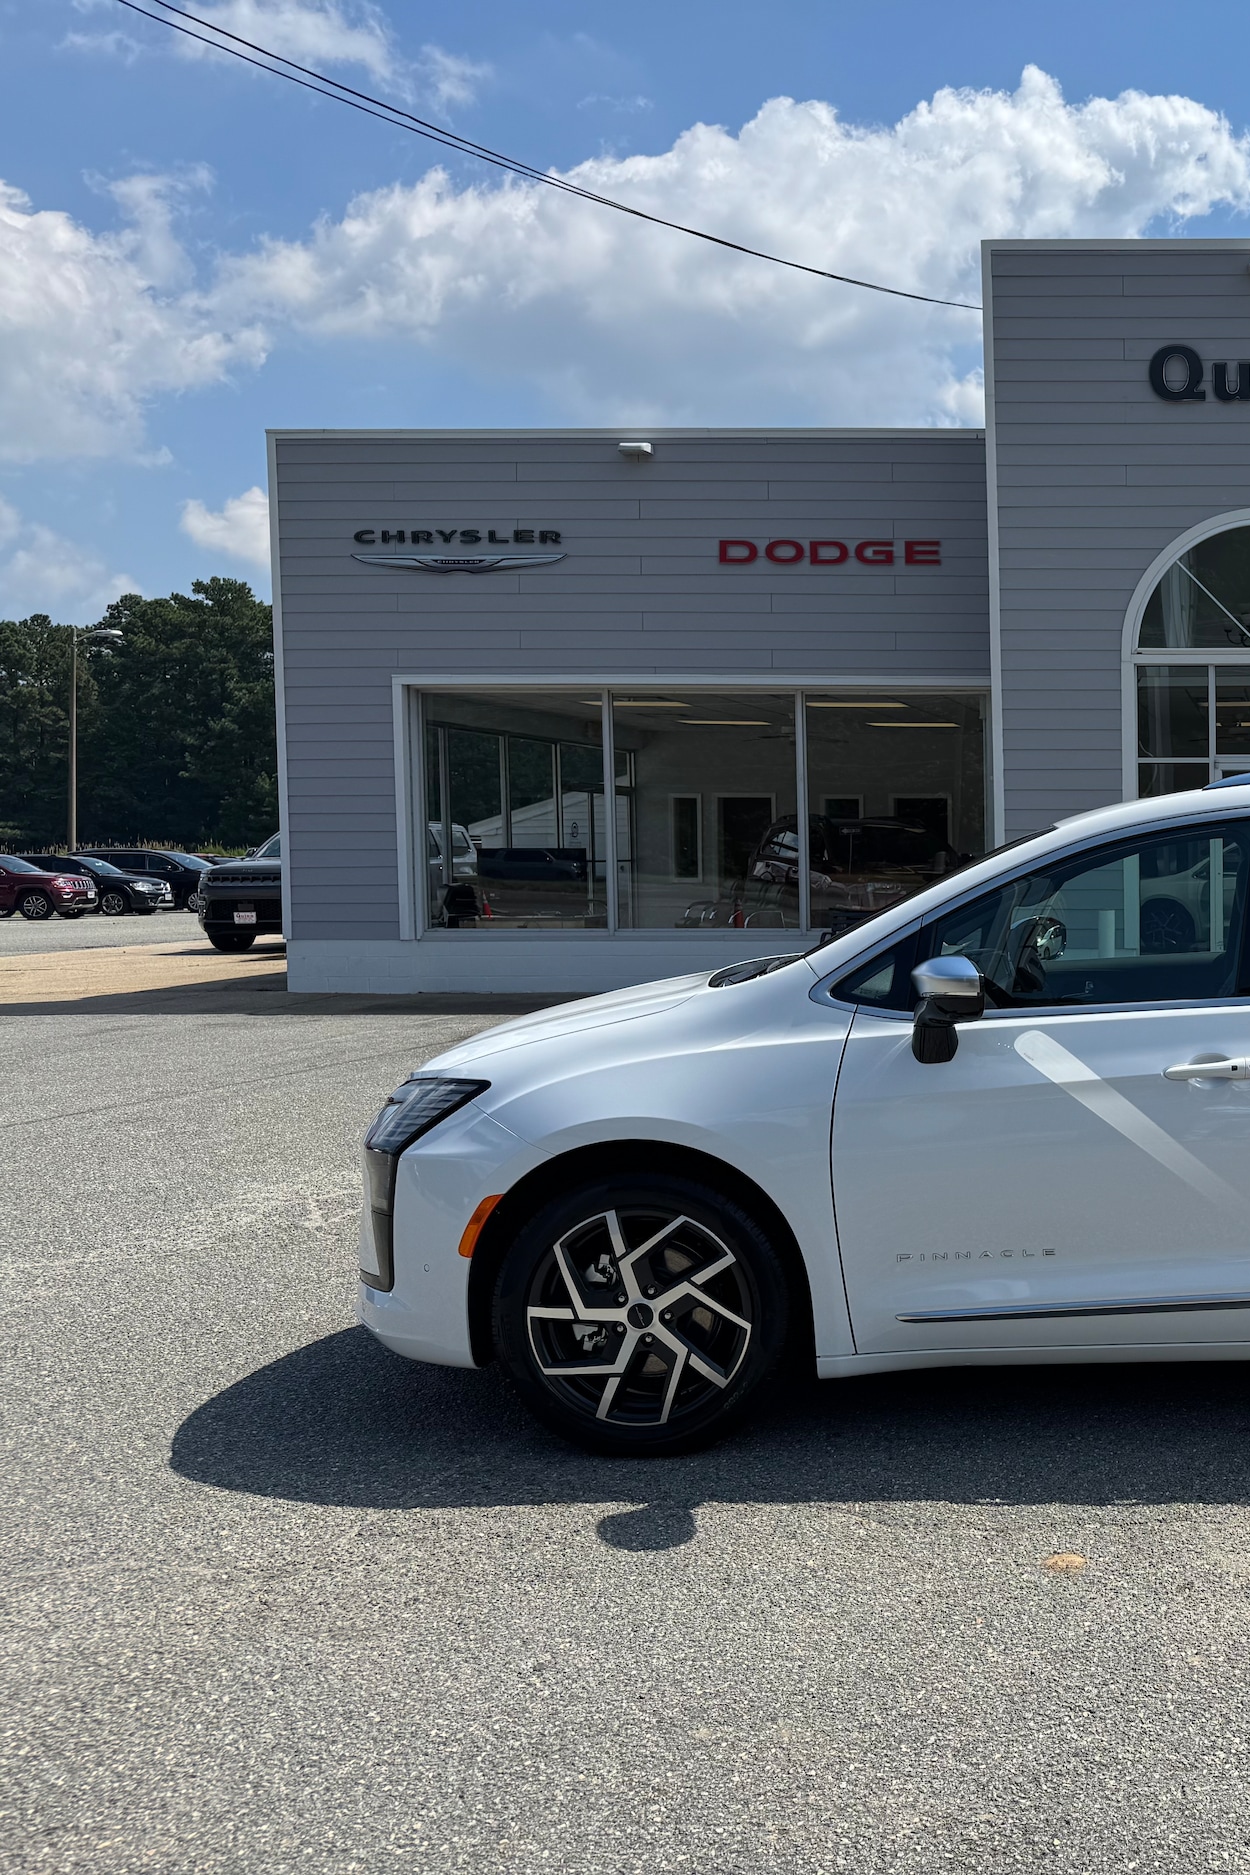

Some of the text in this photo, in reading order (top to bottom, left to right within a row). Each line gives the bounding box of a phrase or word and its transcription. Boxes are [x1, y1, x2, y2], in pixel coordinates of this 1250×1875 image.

[353, 529, 562, 545] CHRYSLER
[718, 539, 942, 566] DODGE
[896, 1248, 1056, 1263] PINNACLE
